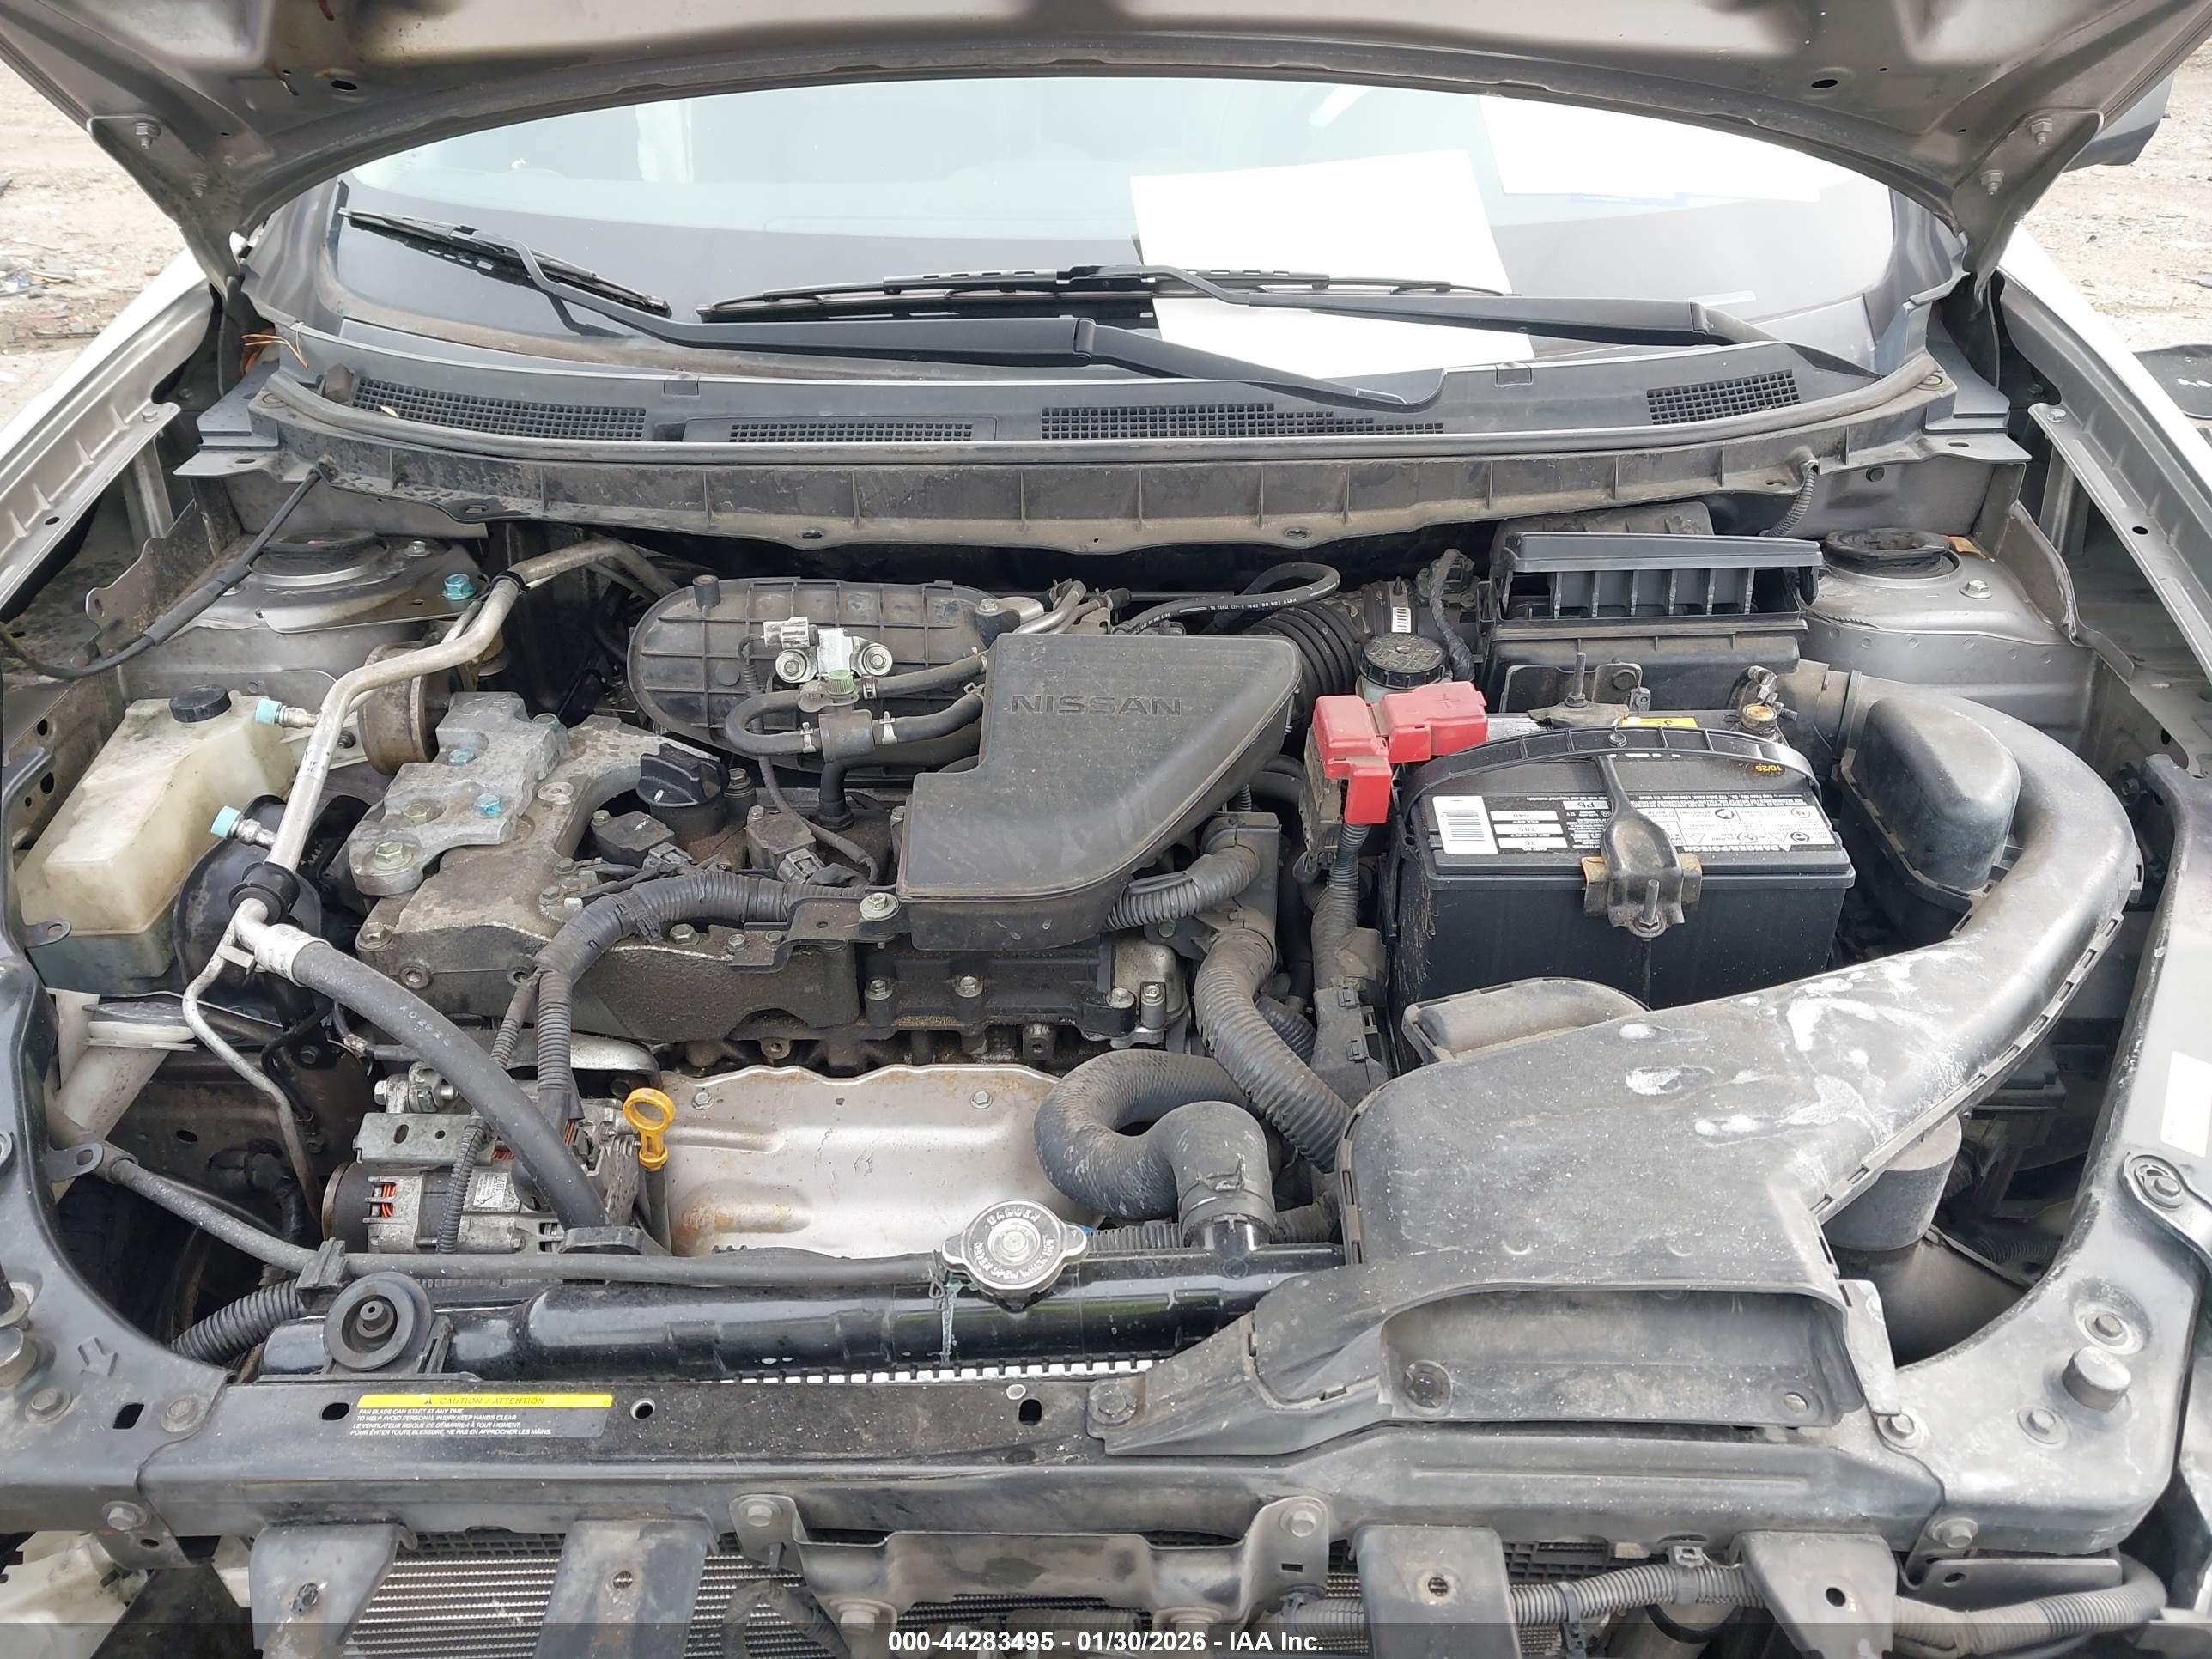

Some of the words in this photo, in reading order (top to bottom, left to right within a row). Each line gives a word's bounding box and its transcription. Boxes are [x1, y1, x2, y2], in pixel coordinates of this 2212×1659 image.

[1011, 695, 1182, 716] NISSAN
[439, 1396, 483, 1406] CAUTION
[492, 1396, 545, 1406] ATTENTION
